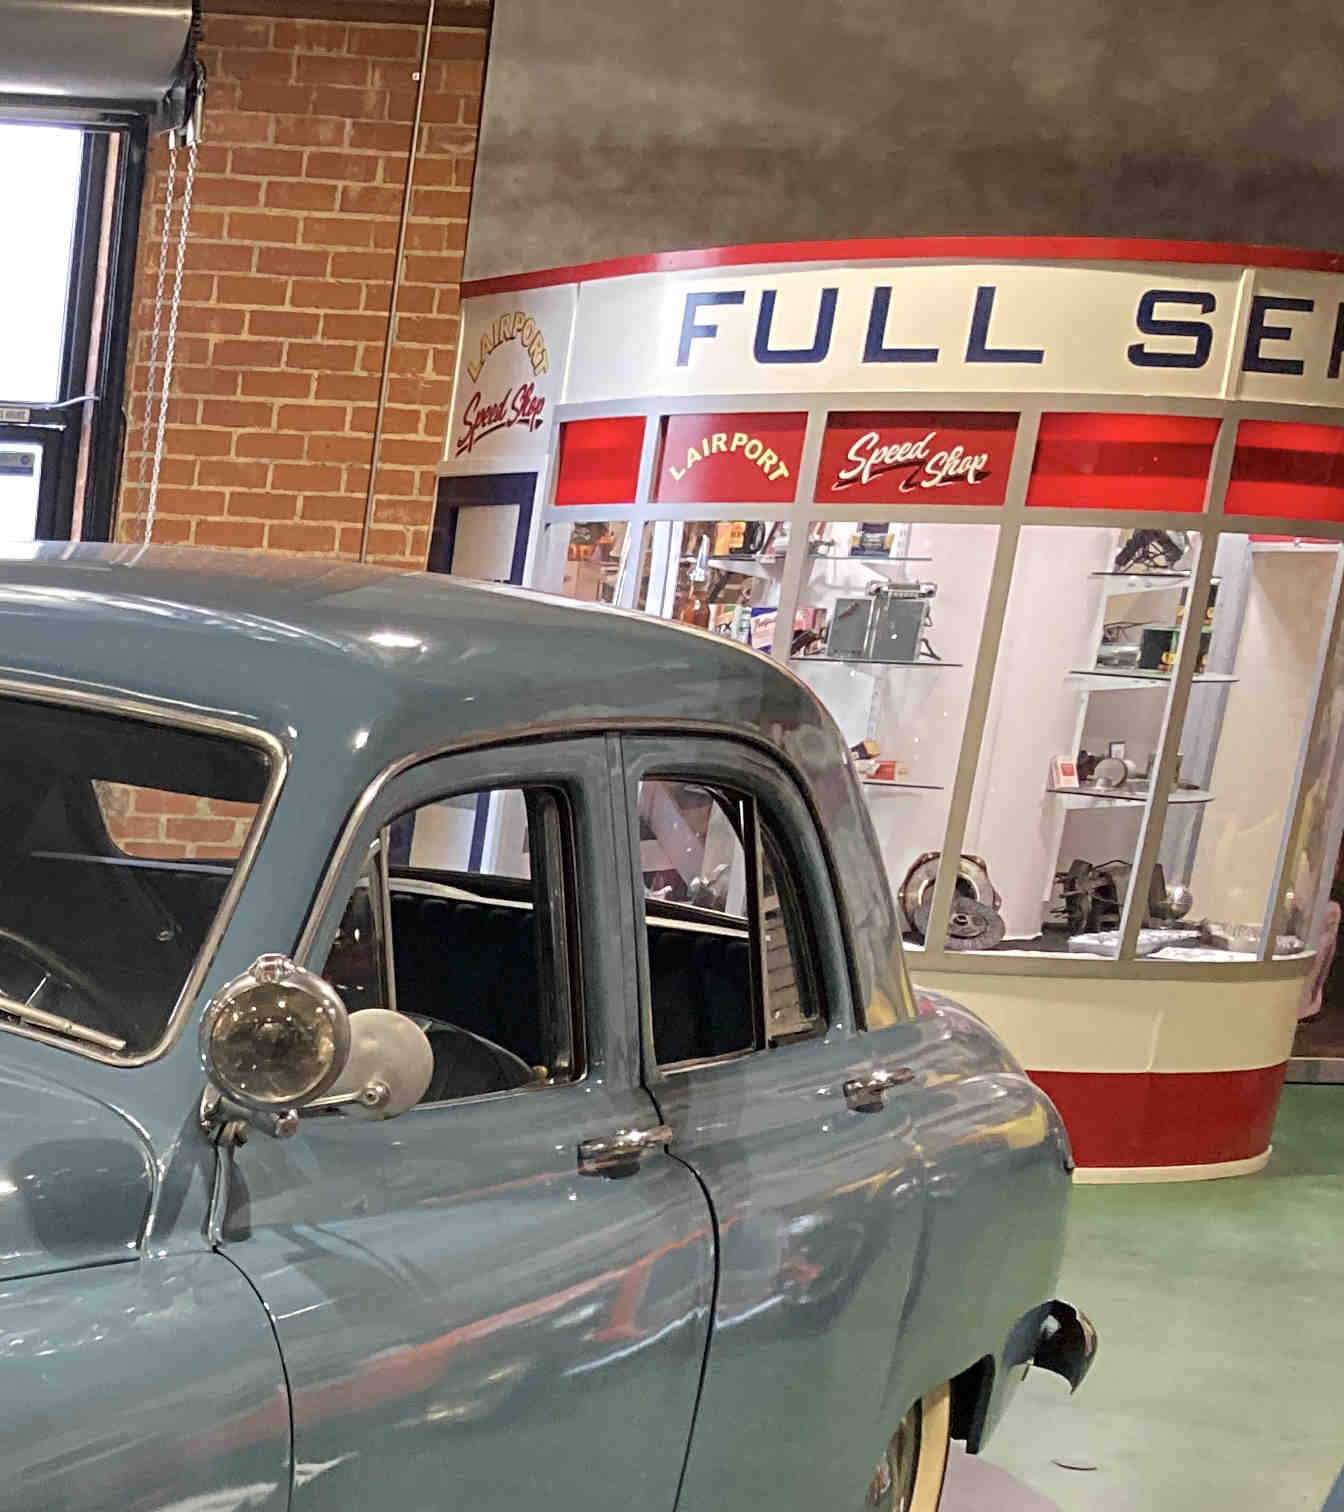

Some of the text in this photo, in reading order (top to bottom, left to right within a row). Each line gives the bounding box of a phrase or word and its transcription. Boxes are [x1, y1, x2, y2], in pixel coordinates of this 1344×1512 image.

[466, 311, 550, 384] LAIRPORT
[676, 285, 1046, 367] FULL
[457, 382, 546, 454] Speed Shop
[669, 432, 790, 482] LAIRPORT
[838, 431, 989, 488] Speed Shop
